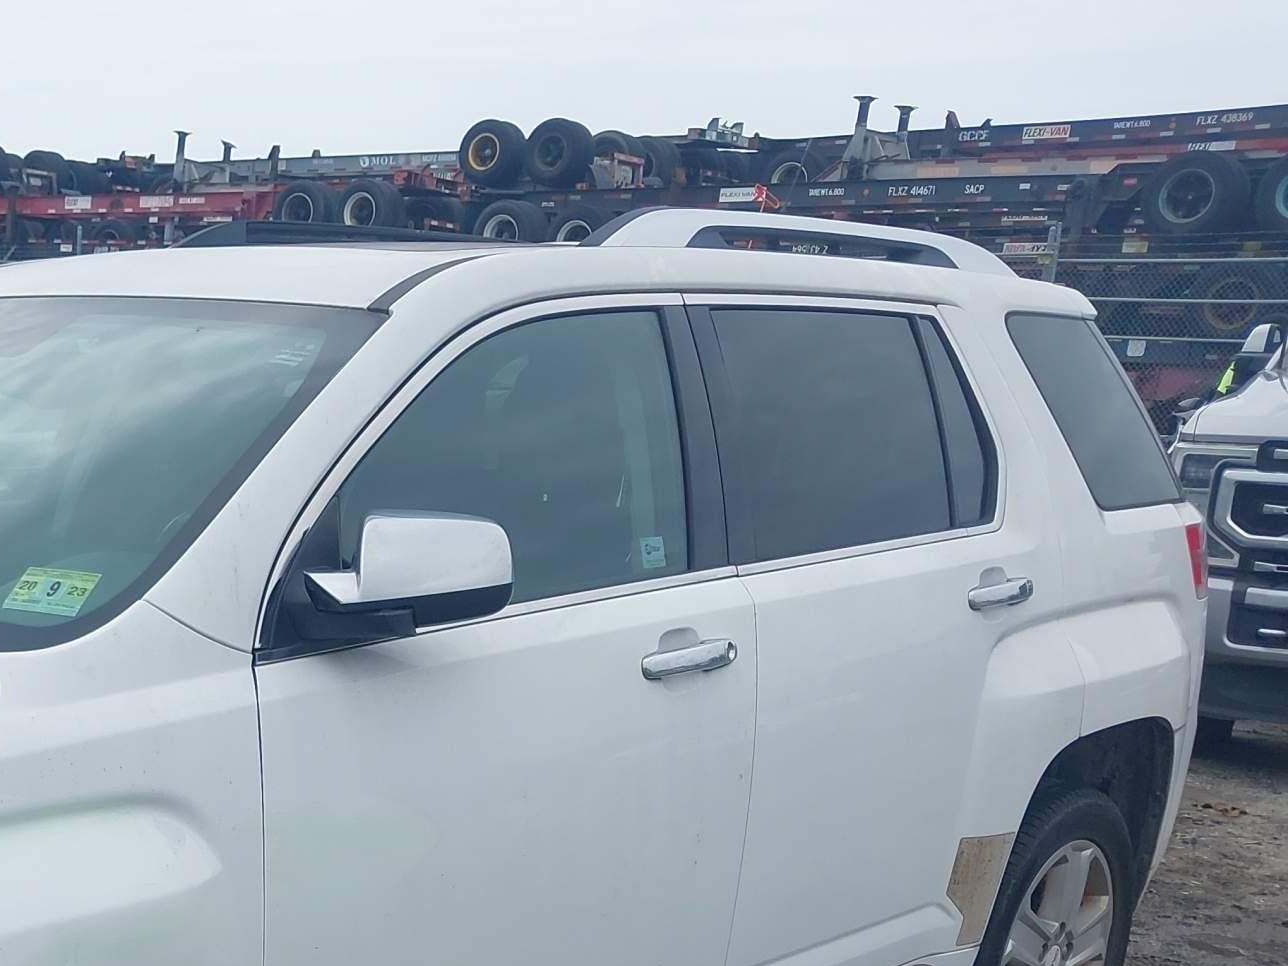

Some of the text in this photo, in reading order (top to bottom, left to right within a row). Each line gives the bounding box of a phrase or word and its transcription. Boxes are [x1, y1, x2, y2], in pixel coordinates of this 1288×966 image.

[1023, 126, 1069, 139] FLEXI-VAN
[370, 156, 396, 167] MOL
[887, 185, 936, 197] FLXZ 414671
[964, 184, 984, 194] SACP
[18, 580, 88, 597] 20 9 23
